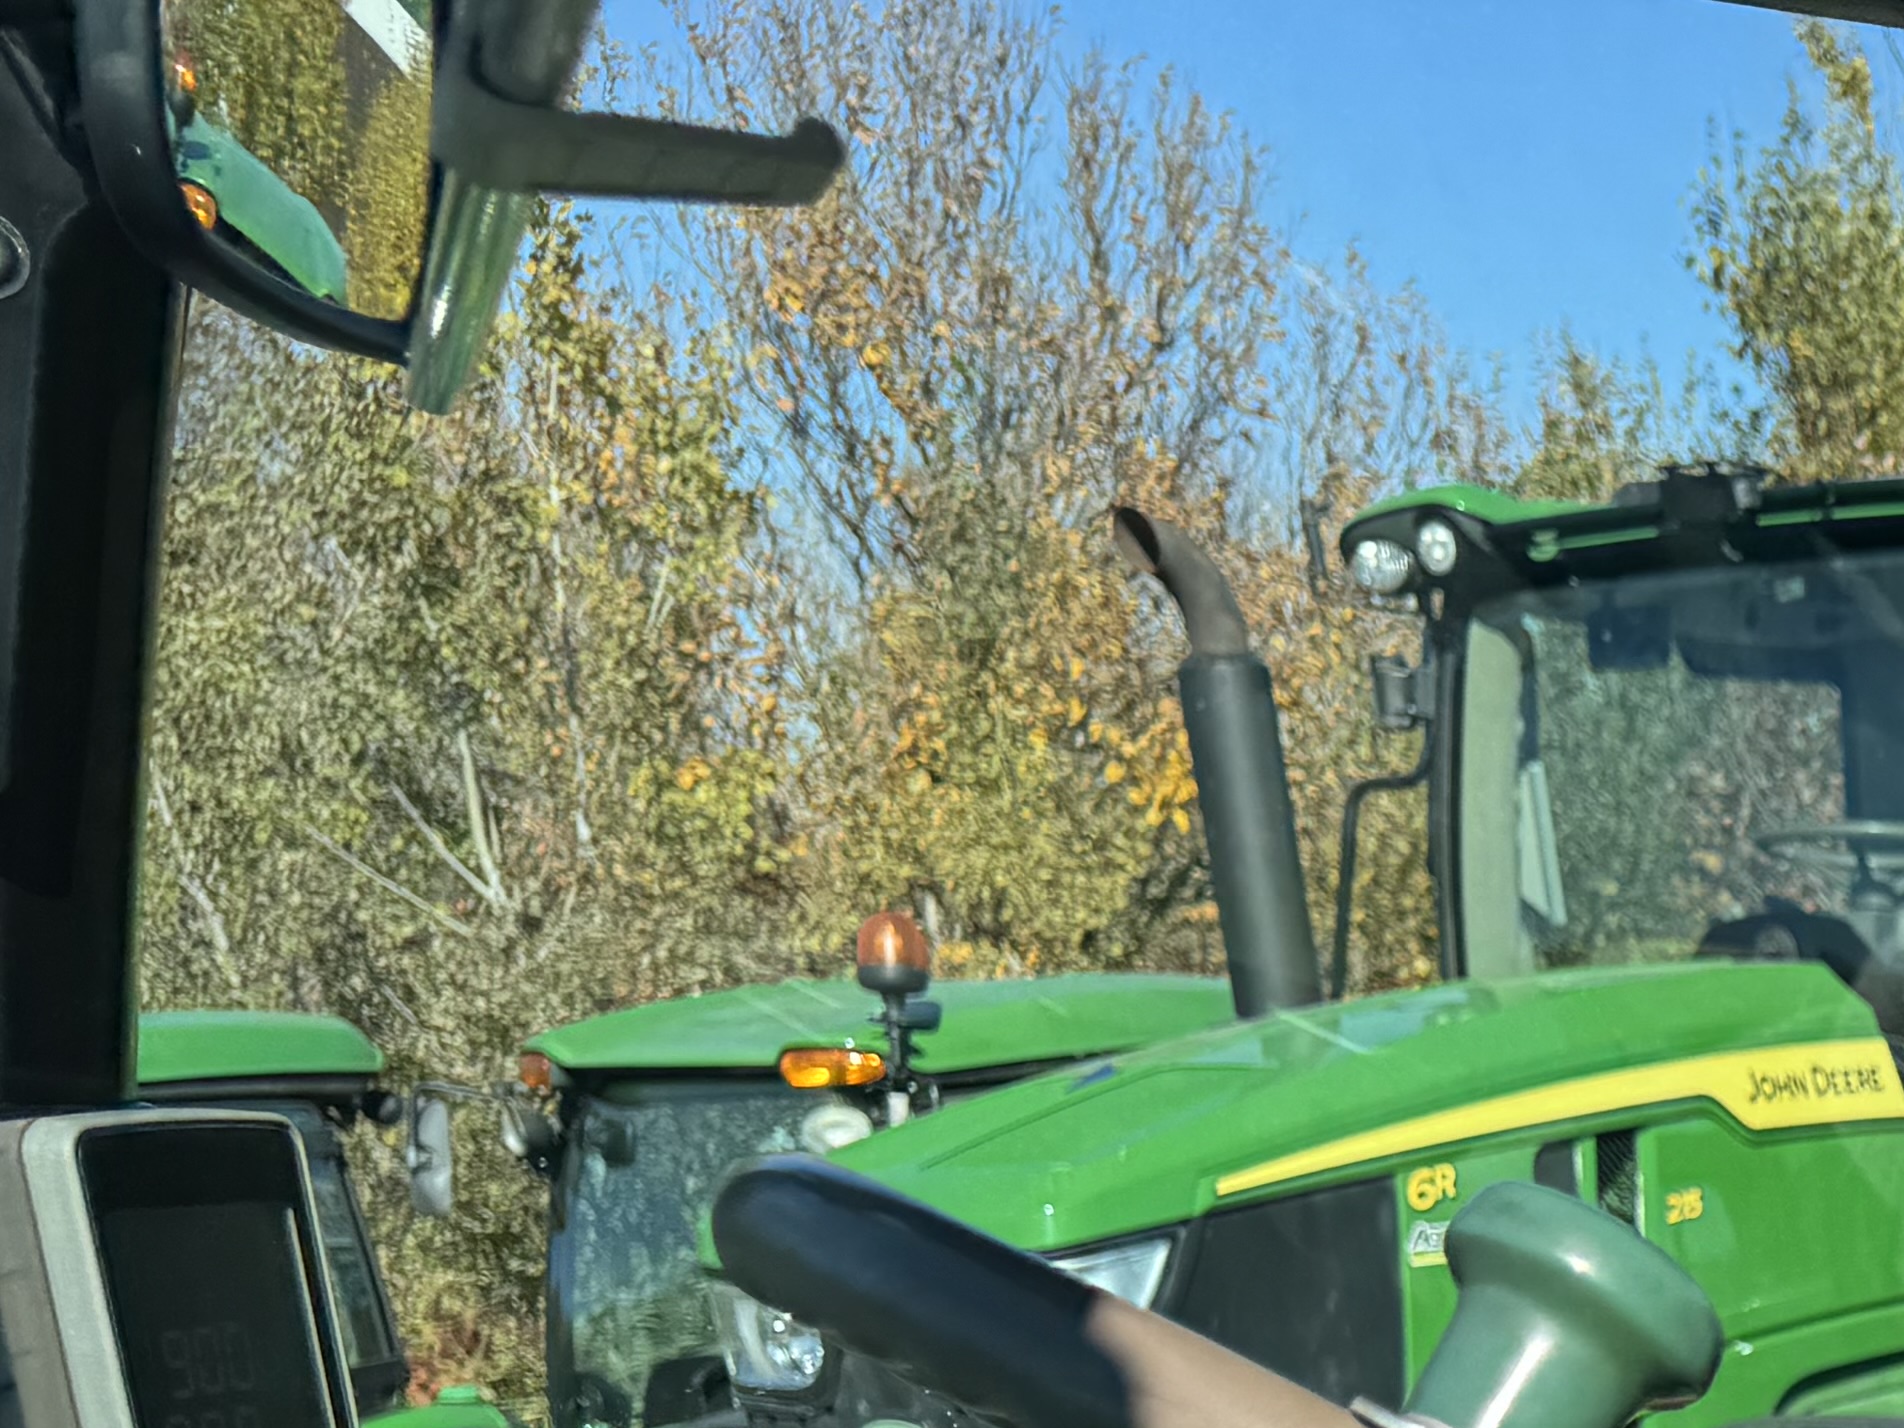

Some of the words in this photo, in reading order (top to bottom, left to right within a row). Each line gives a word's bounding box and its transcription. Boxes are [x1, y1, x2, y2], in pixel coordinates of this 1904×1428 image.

[1749, 1072, 1809, 1103] JOHN
[1812, 1065, 1884, 1097] DEERE
[1407, 1162, 1457, 1212] 6R
